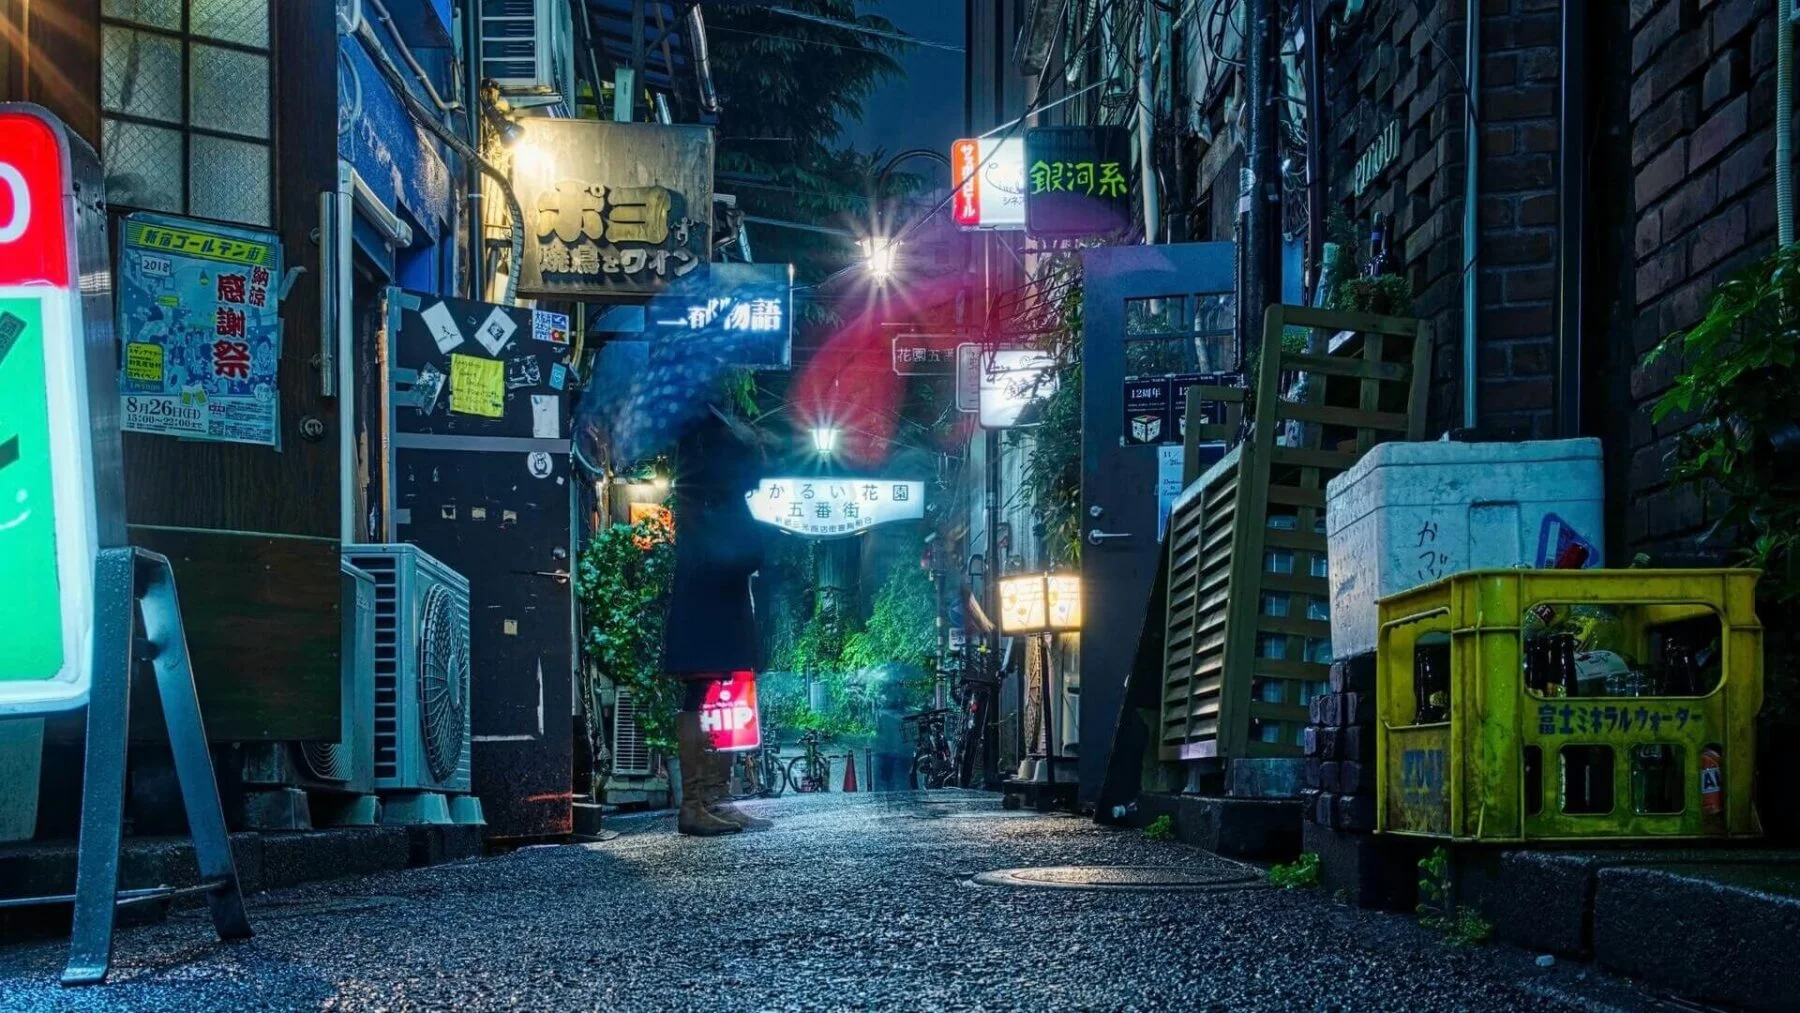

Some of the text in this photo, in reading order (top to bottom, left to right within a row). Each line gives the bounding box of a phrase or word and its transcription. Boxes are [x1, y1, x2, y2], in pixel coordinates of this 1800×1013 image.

[1029, 160, 1128, 198] 銀河系
[145, 226, 261, 261] 新宿ゴールデン街
[539, 240, 698, 276] 焼鳥とワイン
[143, 260, 170, 273] 2018
[213, 273, 252, 379] 感謝祭
[126, 396, 201, 420] 8月26日(日)
[788, 501, 860, 519] 五番街
[1537, 704, 1705, 735] 富士ミネラルウォーター
